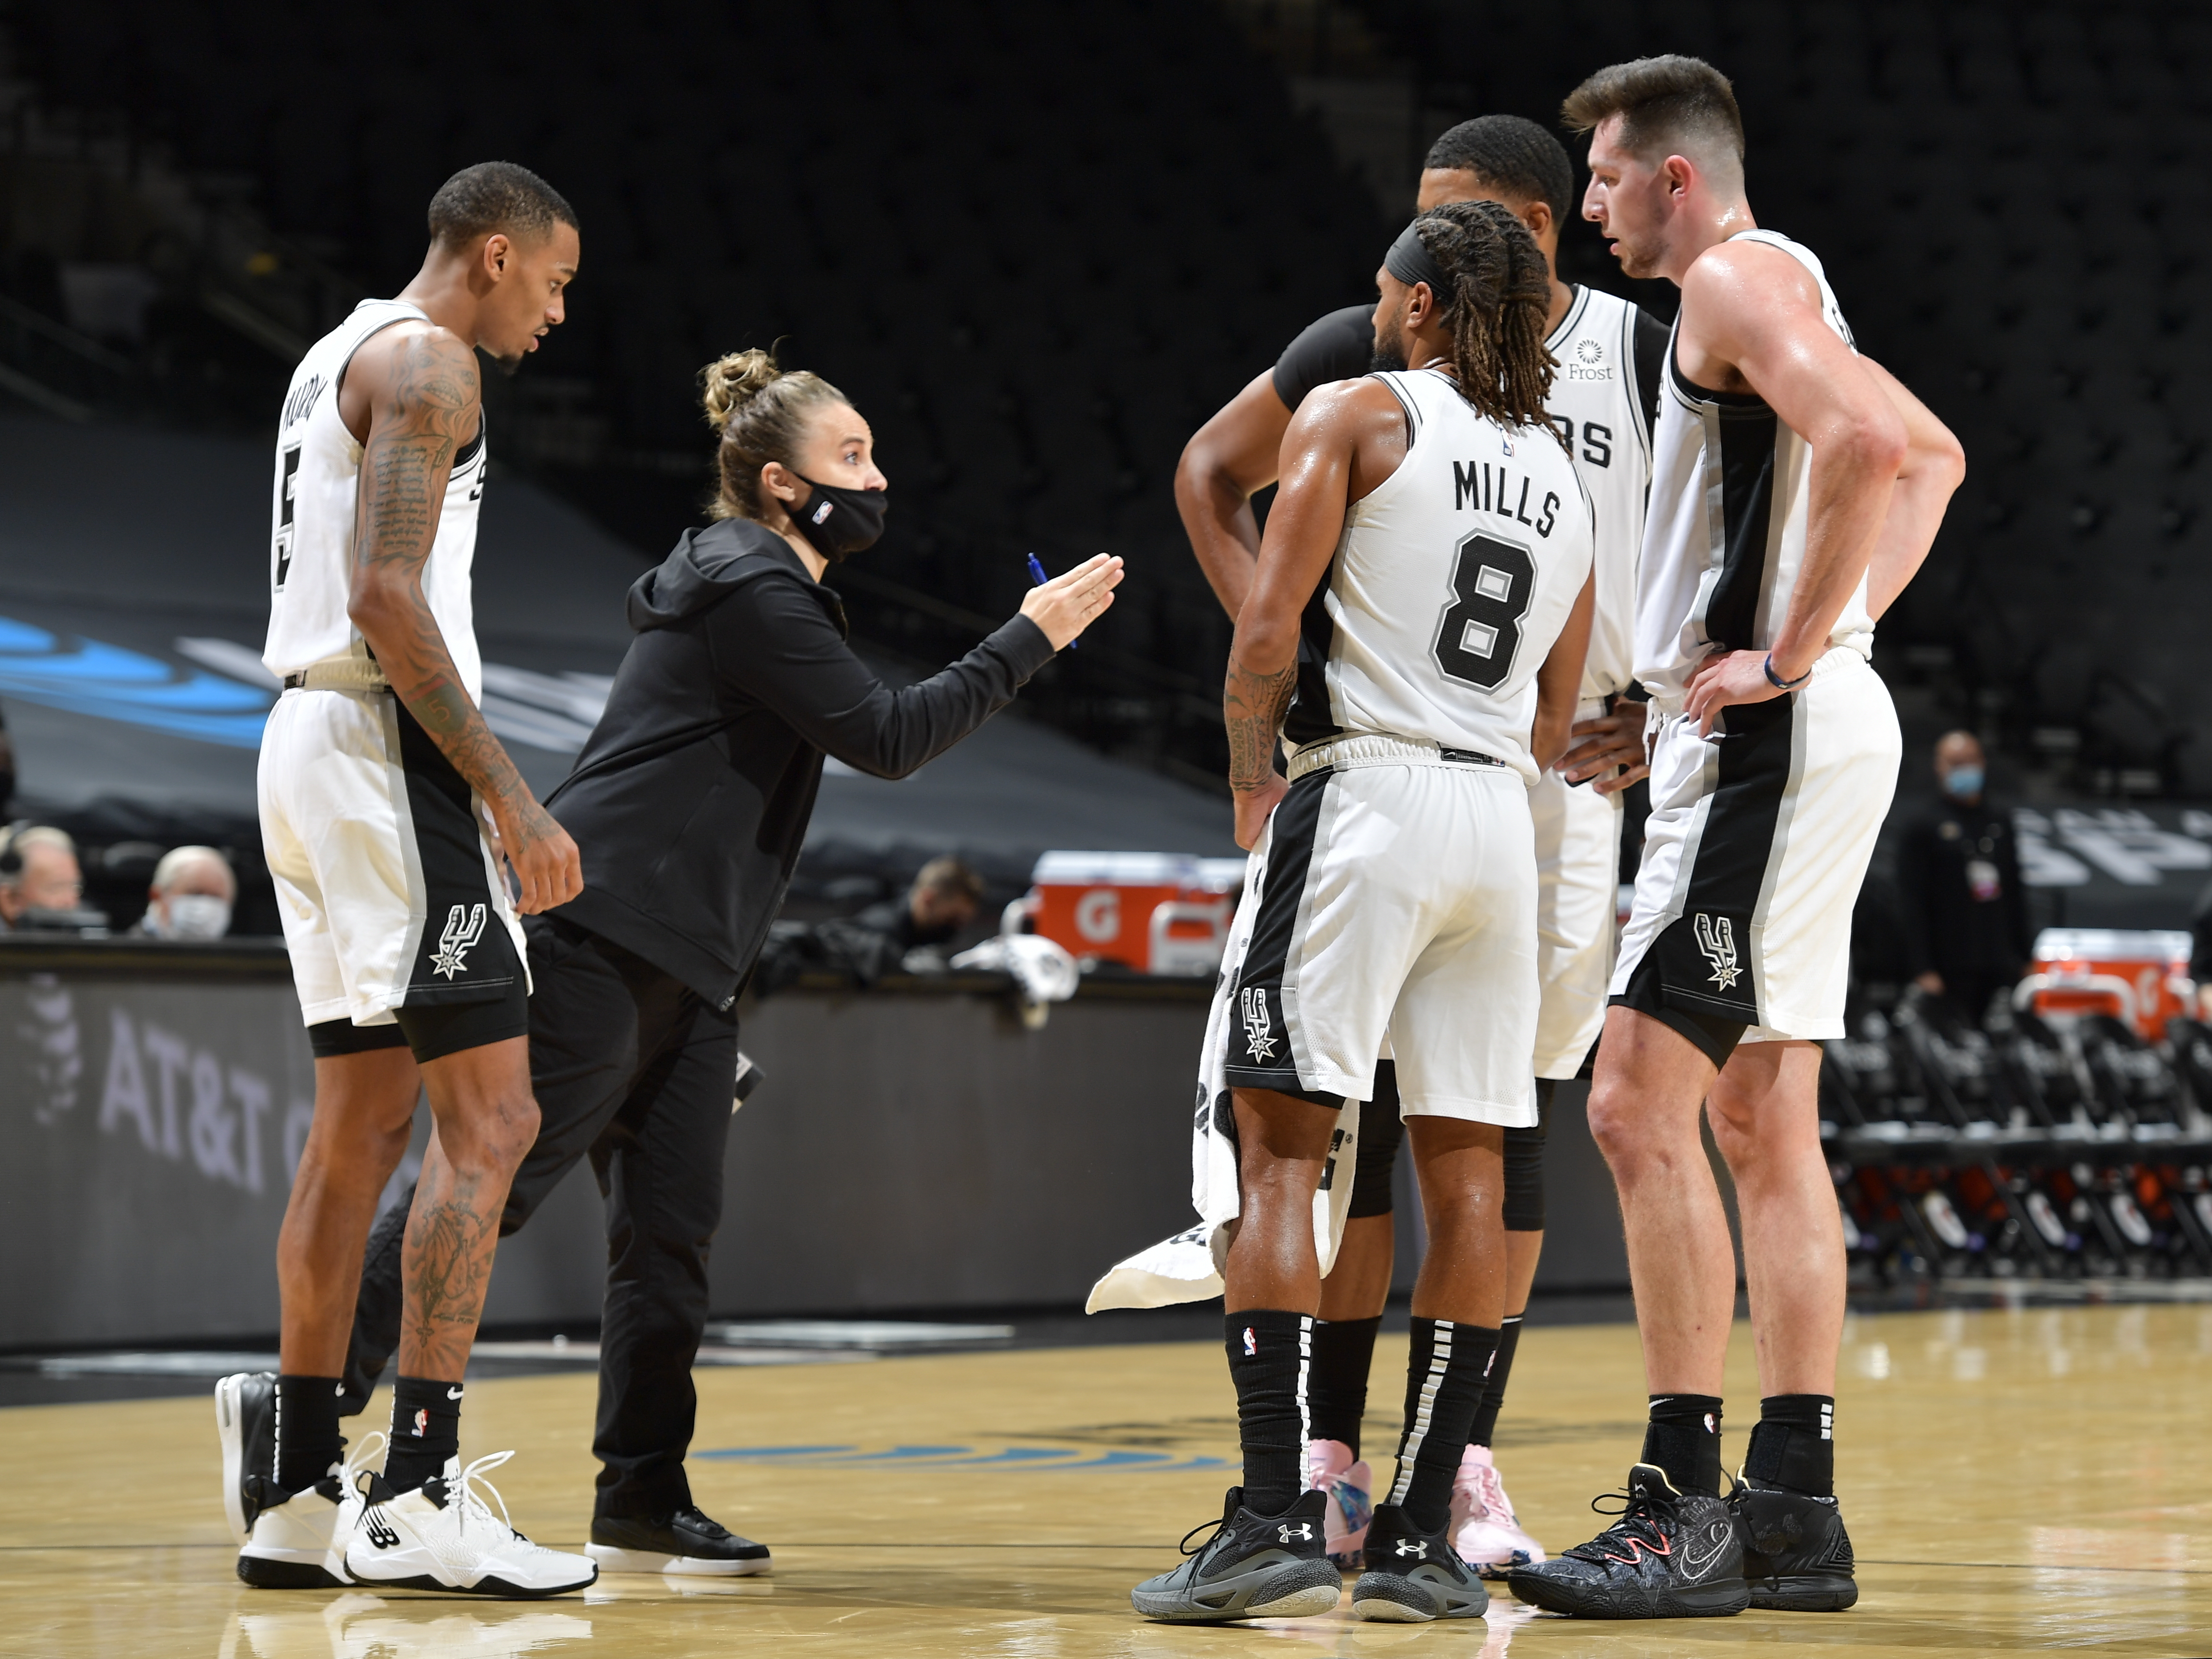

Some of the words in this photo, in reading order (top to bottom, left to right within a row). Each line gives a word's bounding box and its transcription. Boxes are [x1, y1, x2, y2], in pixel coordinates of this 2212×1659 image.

[1569, 363, 1614, 380] Frost
[1452, 460, 1561, 539] MILLS
[1428, 527, 1539, 696] 8
[1074, 888, 1120, 944] G
[99, 1007, 271, 1196] AT&T
